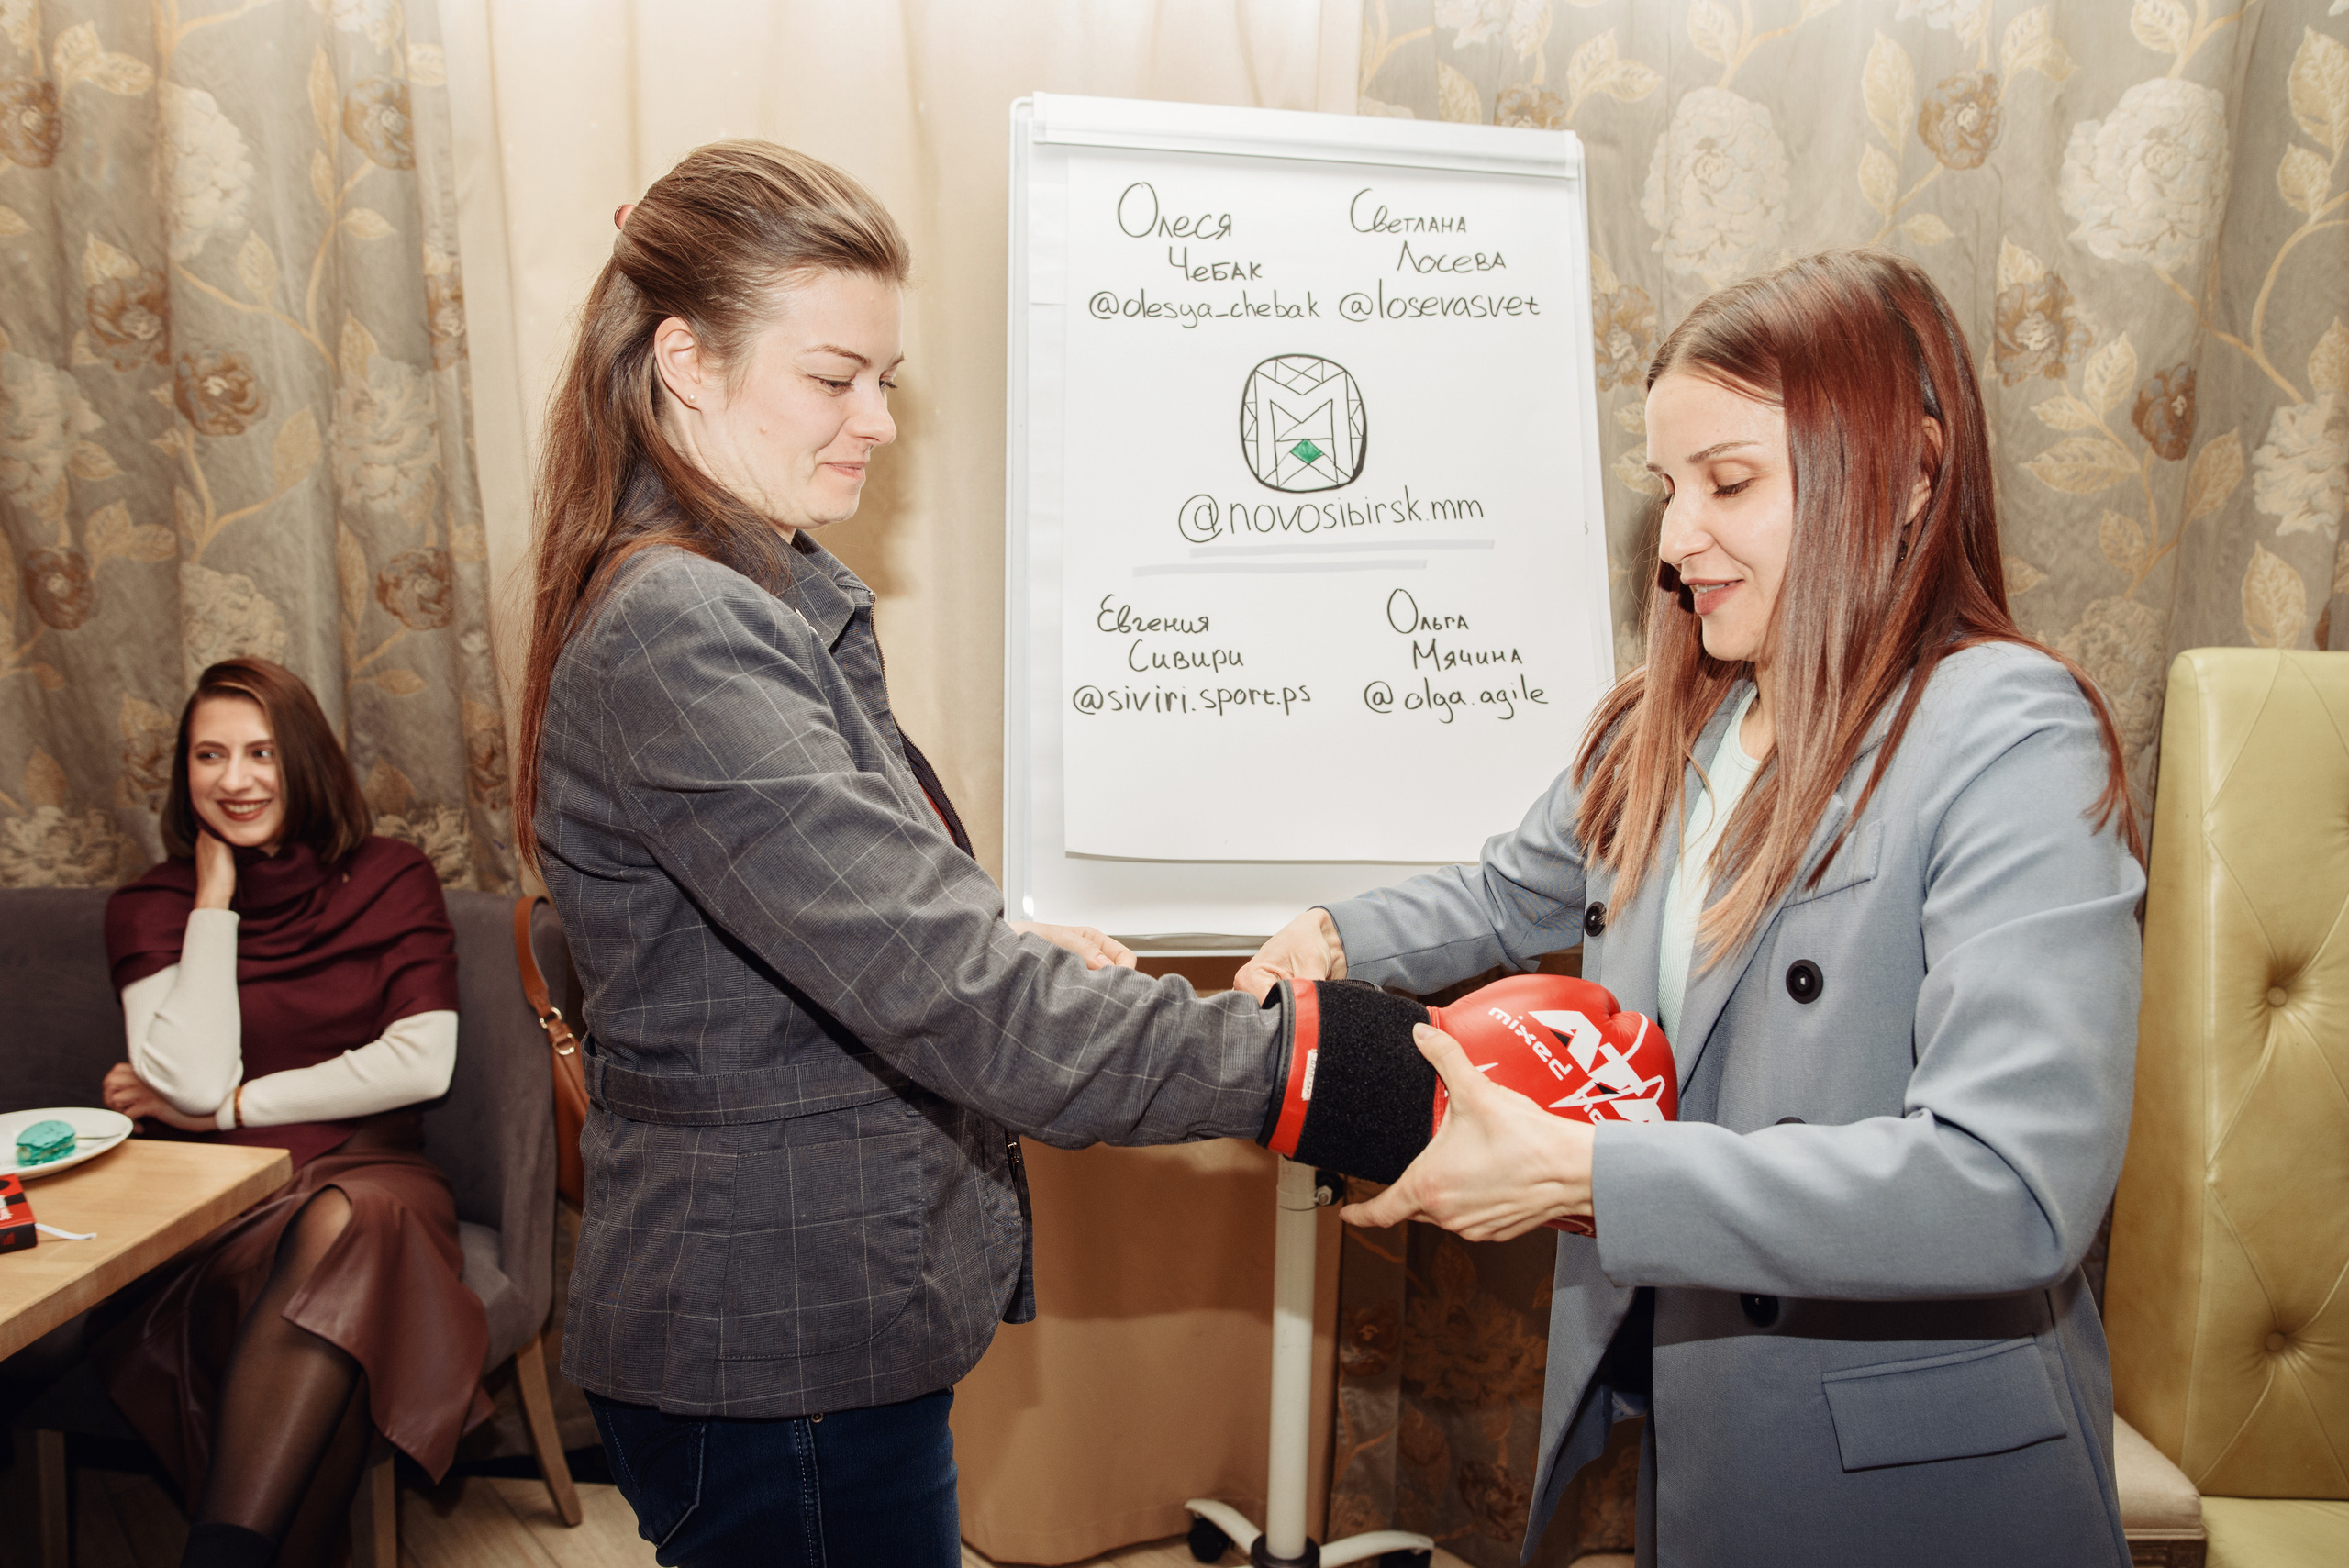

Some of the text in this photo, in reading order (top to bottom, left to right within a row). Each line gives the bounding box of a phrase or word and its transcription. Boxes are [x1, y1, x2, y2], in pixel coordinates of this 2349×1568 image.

[1118, 182, 1231, 240] Олеся
[1088, 288, 1321, 329] @olesya_chebak
[1339, 278, 1542, 323] @losevasvet
[1178, 485, 1485, 544] @novosibirsk.mm
[1097, 594, 1209, 634] Евгения
[1128, 639, 1244, 673] Сивири
[1073, 684, 1311, 717] @siviri.sport.ps
[1488, 1007, 1573, 1081] mixed
